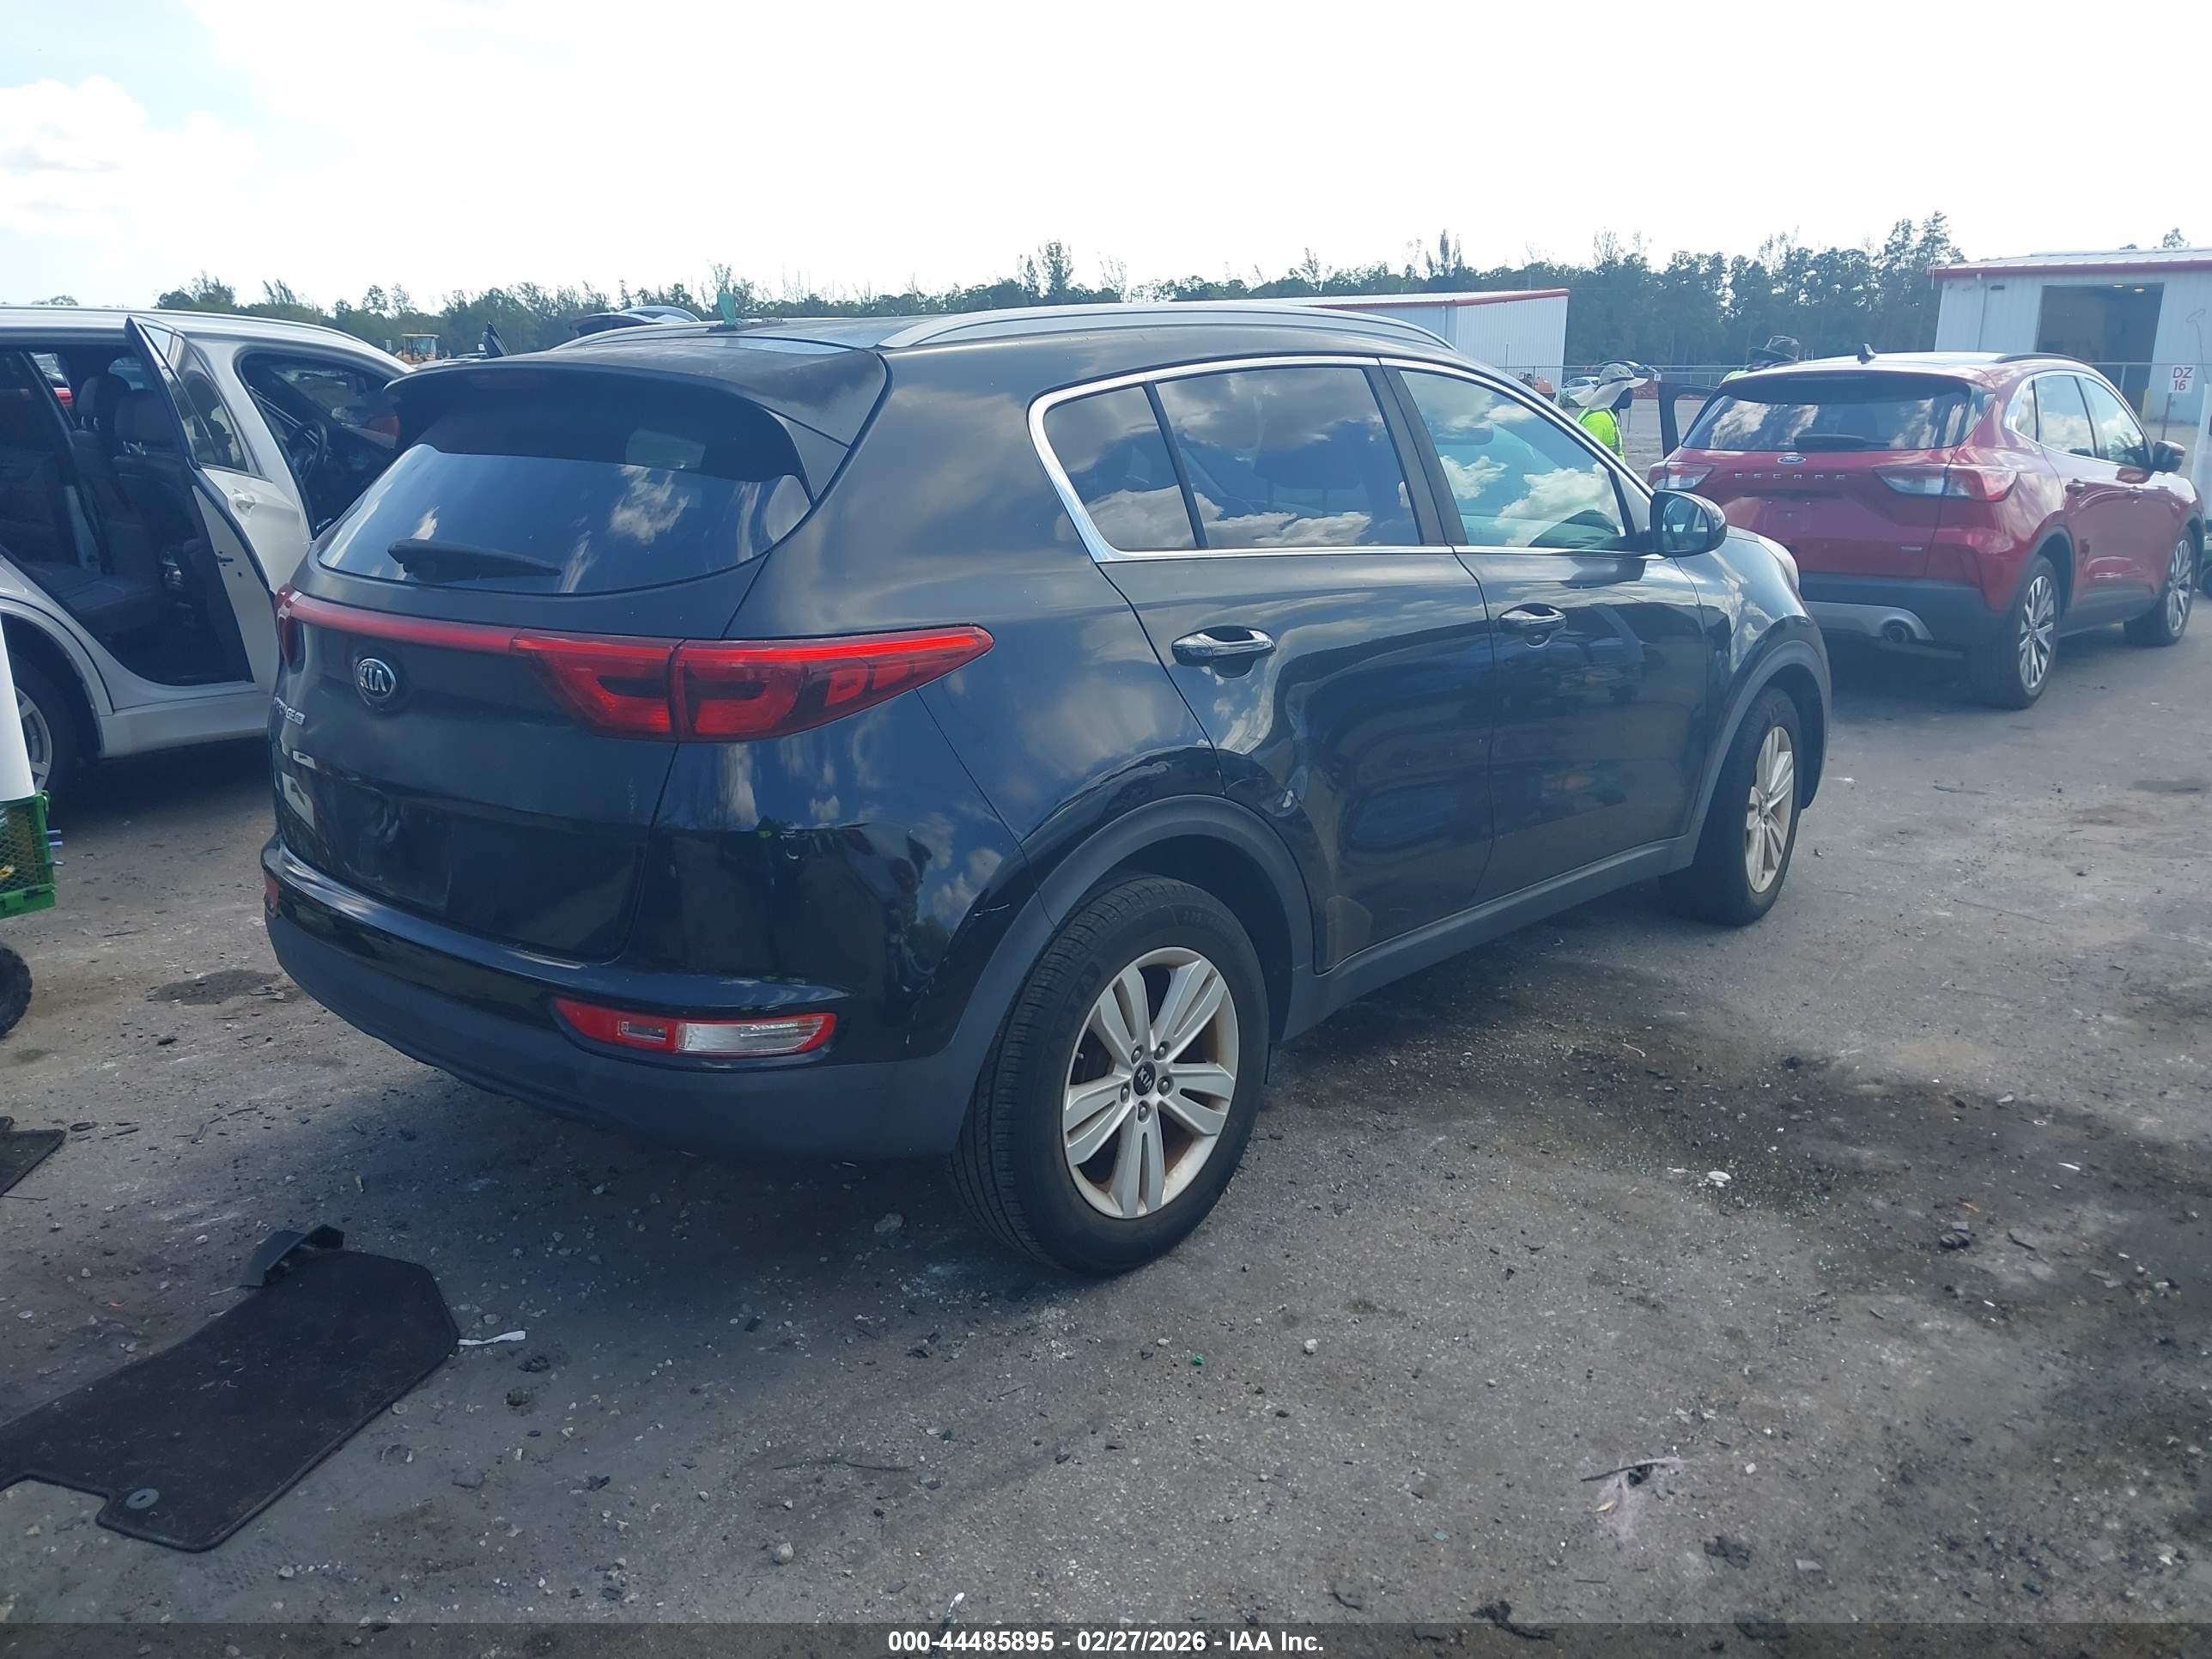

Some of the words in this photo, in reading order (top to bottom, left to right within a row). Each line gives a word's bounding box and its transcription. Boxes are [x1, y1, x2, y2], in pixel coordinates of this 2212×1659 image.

[2172, 367, 2193, 379] DZ
[2174, 380, 2186, 392] 16
[359, 666, 387, 692] KIA
[1138, 1067, 1152, 1091] KIA
